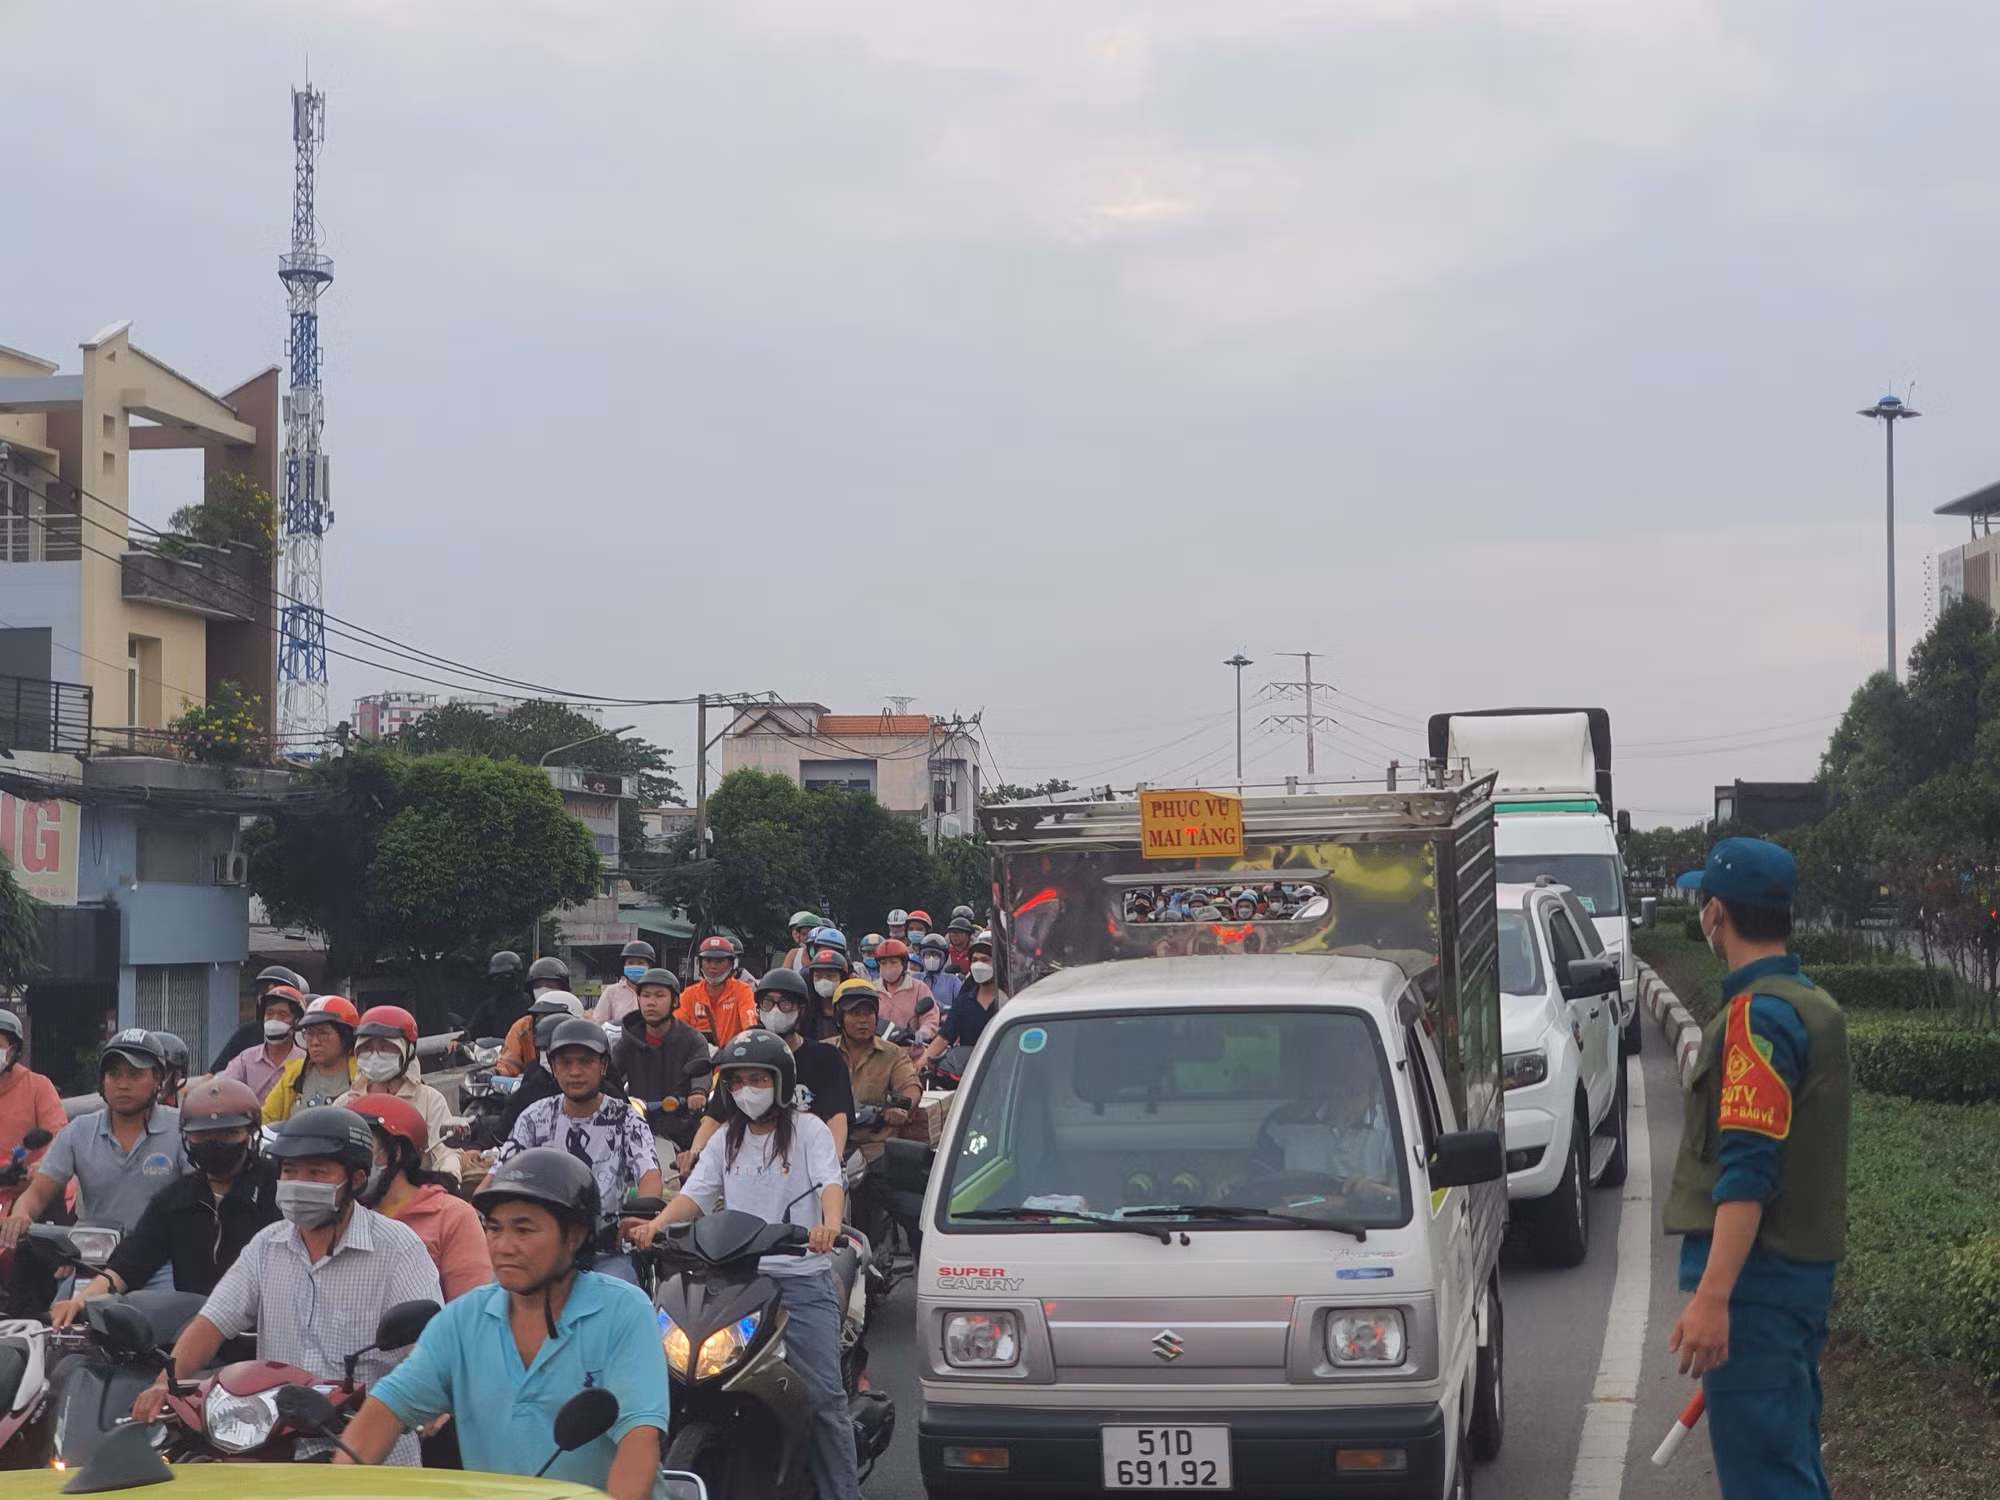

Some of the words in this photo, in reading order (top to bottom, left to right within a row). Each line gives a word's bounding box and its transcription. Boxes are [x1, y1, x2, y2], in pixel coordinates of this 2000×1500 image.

[1150, 799, 1200, 821] PHỤC
[1205, 798, 1230, 821] VỤ
[1148, 829, 1182, 848] MAI
[1186, 823, 1236, 846] TÁNG
[936, 1277, 1025, 1291] CARRY
[938, 1267, 1005, 1277] SUPER
[1137, 1429, 1193, 1456] 51D
[1117, 1460, 1218, 1486] 691.92
